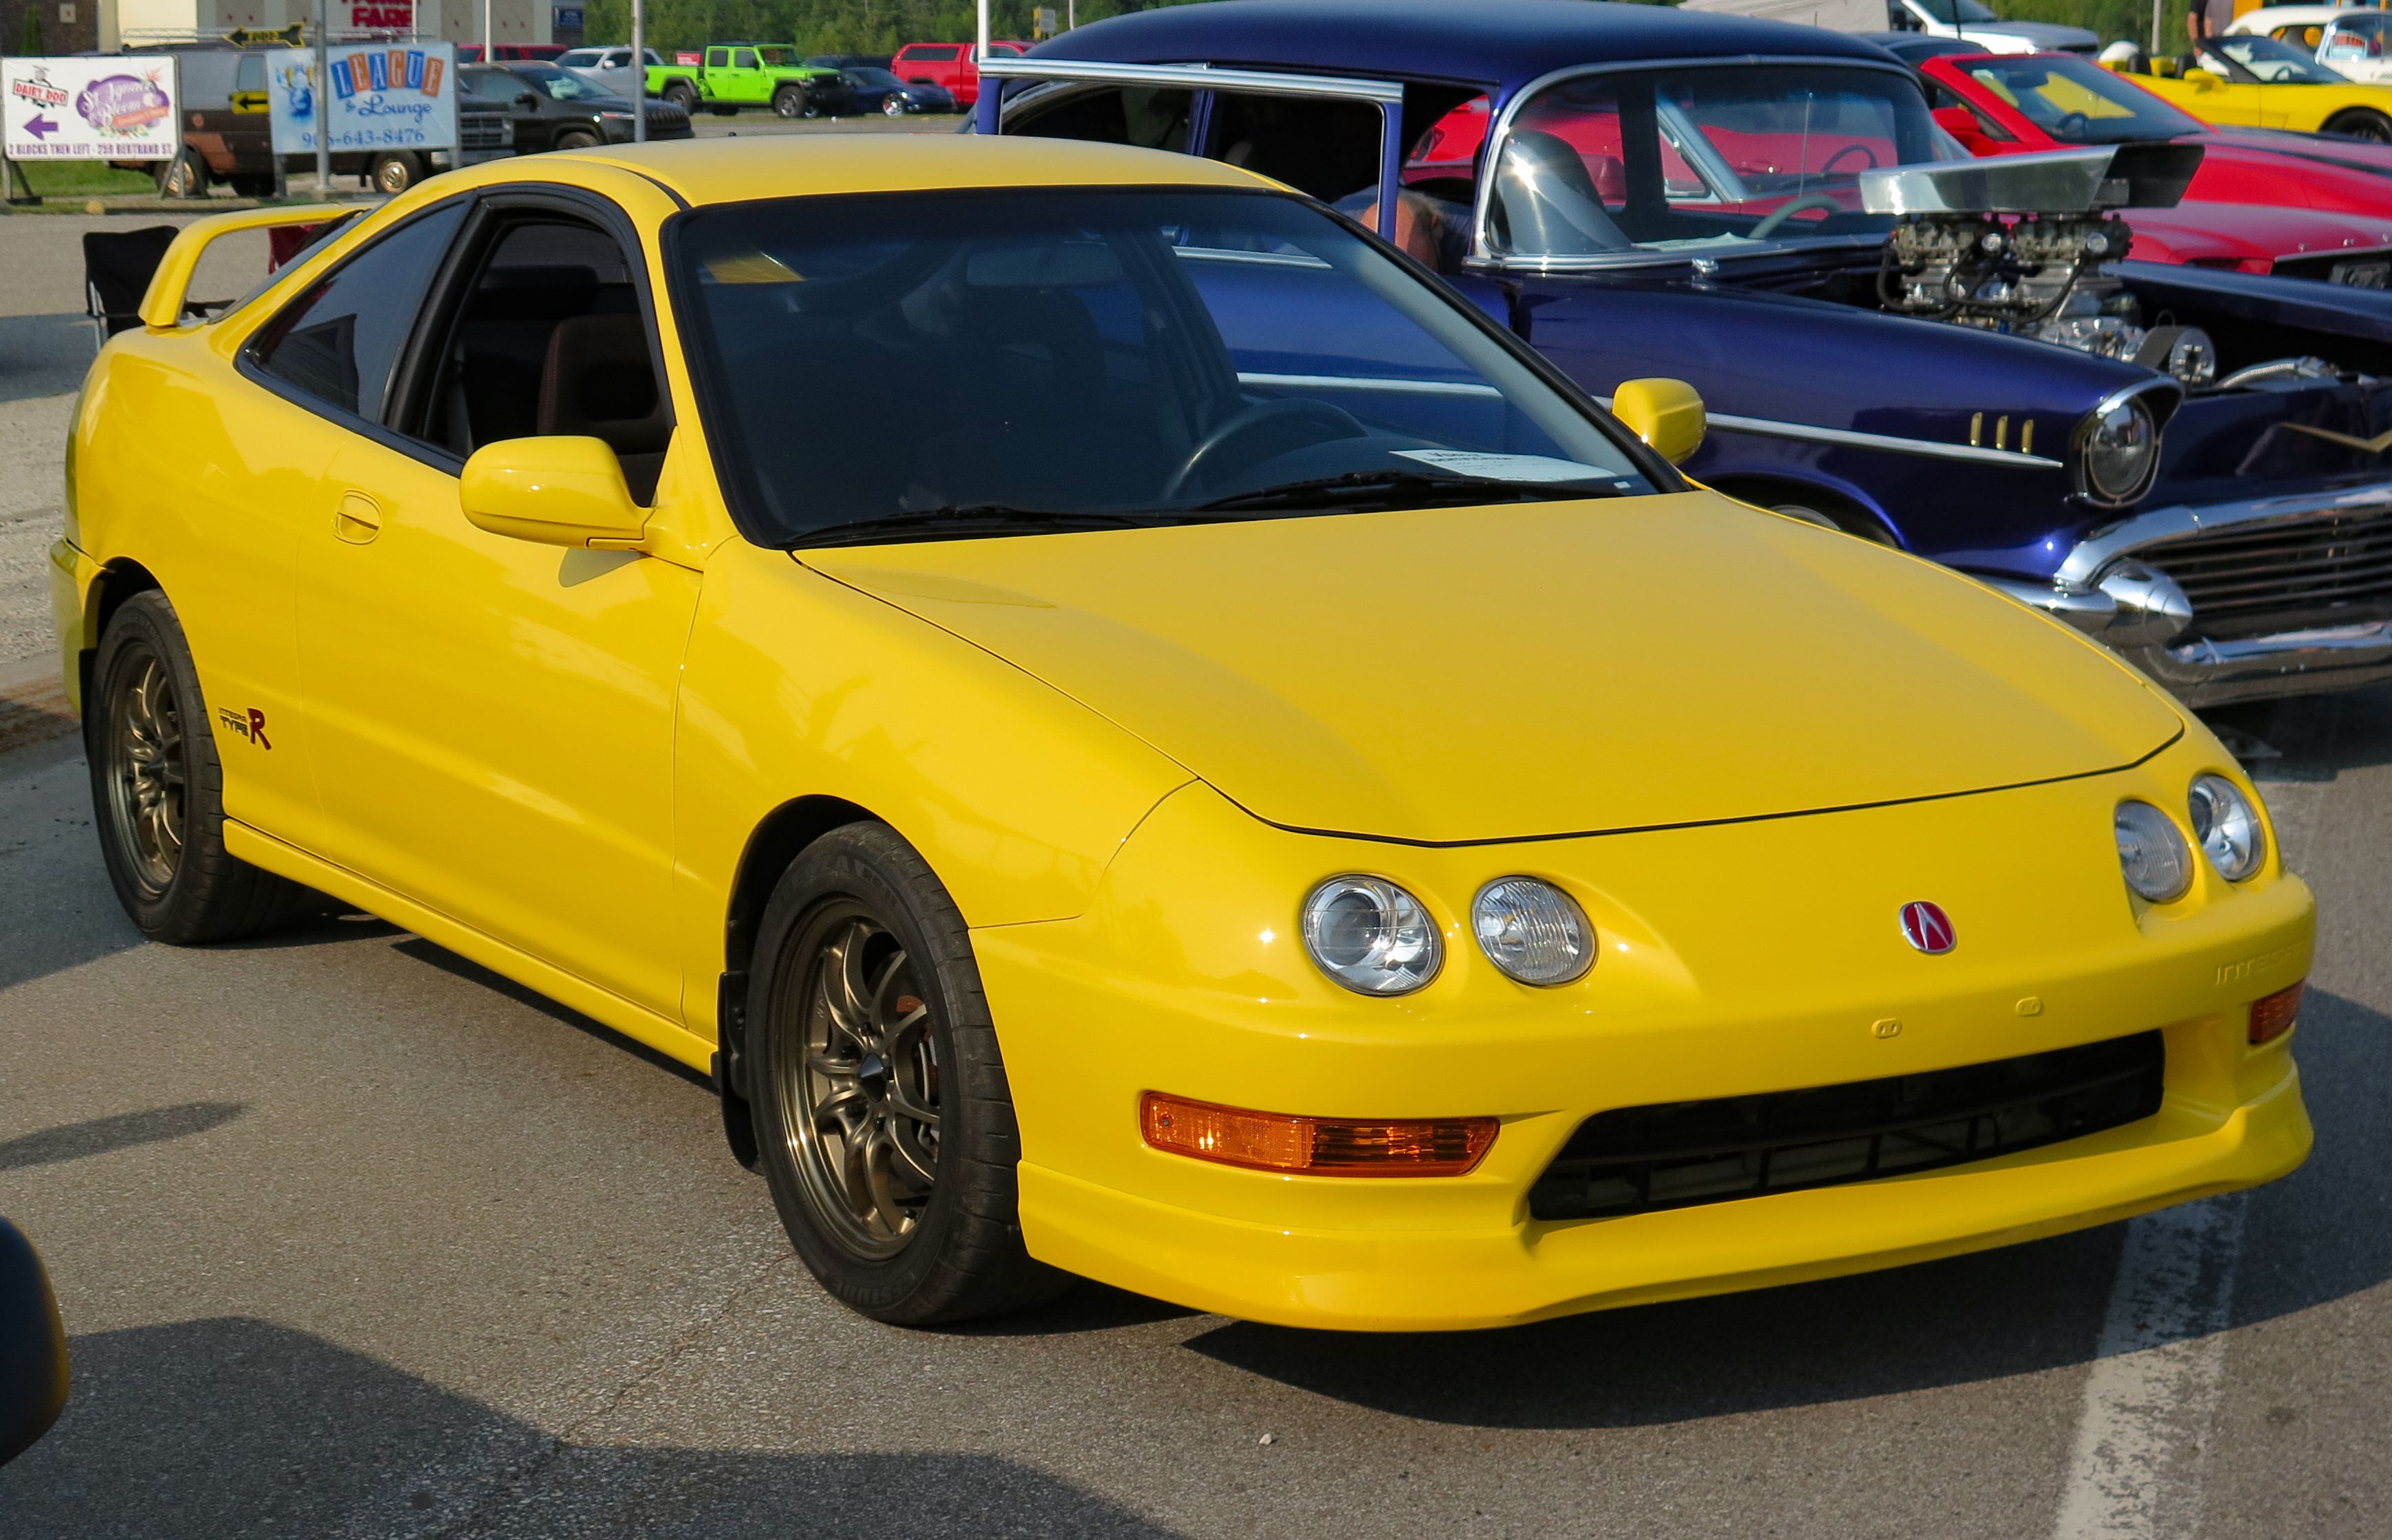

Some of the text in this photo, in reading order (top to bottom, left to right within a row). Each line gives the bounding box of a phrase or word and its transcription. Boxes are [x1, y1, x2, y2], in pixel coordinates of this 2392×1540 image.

[334, 51, 441, 96] LEAGUE
[358, 94, 432, 124] Lounge
[17, 143, 47, 155] BLOCKS
[50, 143, 71, 155] THEN
[73, 143, 90, 155] LEFT
[301, 127, 426, 145] 9-643-8476
[247, 708, 272, 750] R
